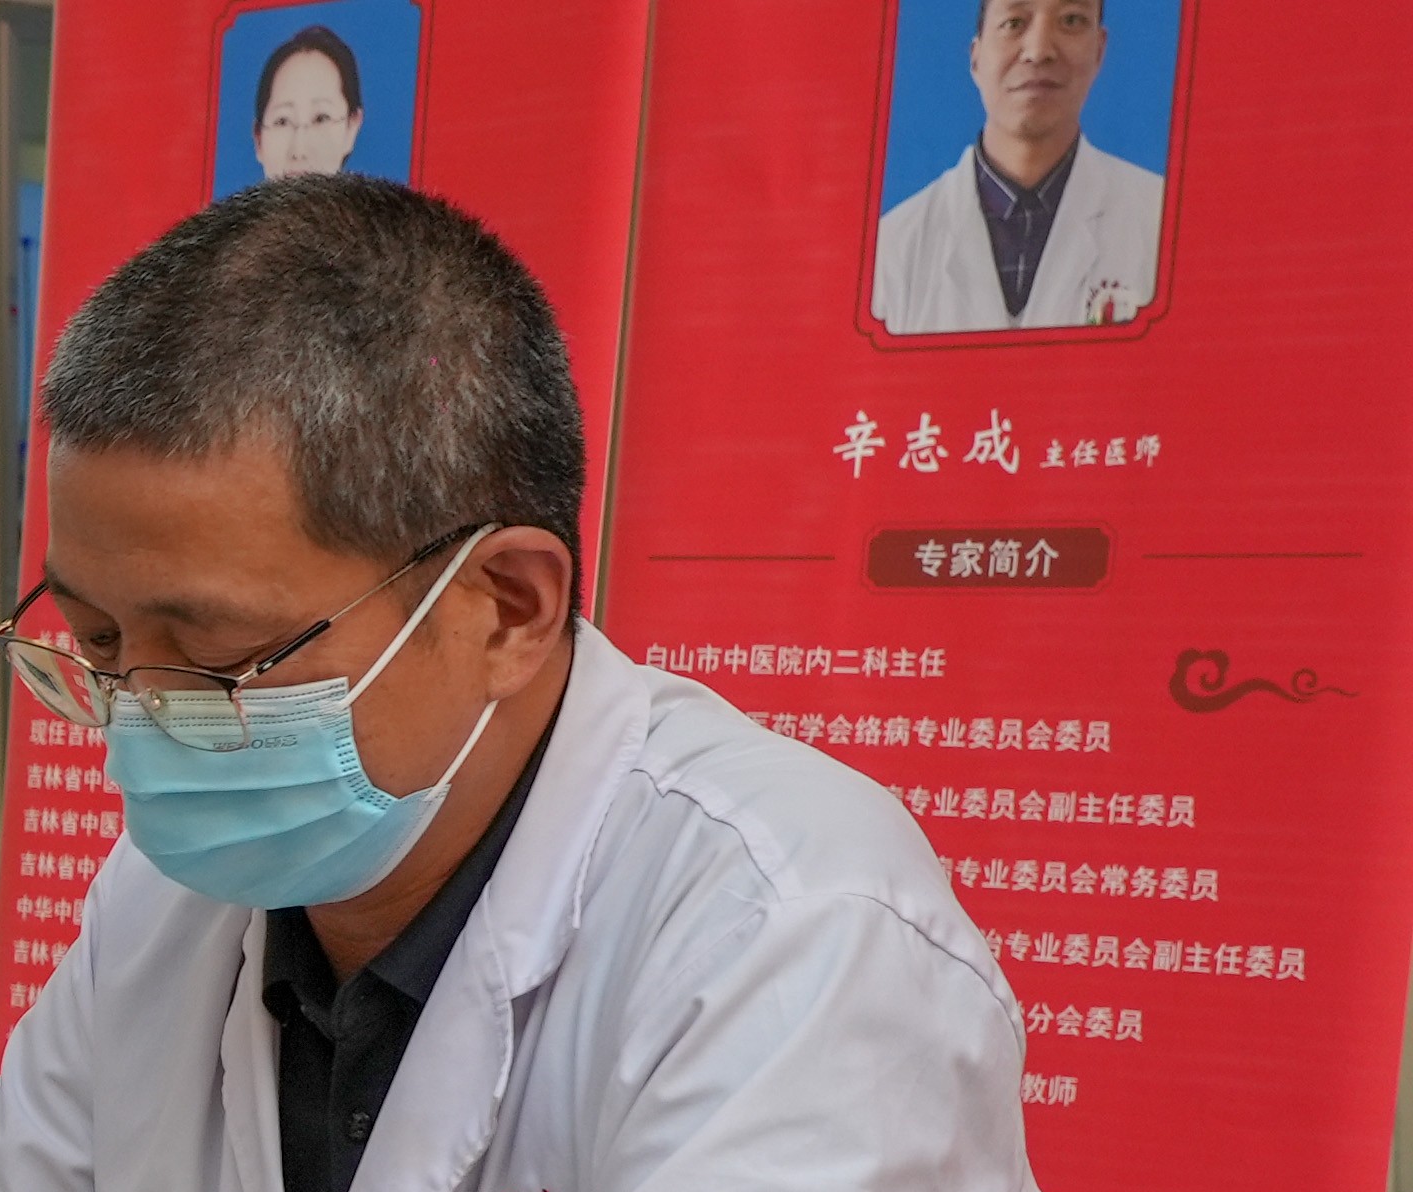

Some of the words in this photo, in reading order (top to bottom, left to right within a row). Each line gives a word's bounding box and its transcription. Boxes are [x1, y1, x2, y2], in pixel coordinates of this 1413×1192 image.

[833, 408, 1020, 479] 辛志成
[1040, 433, 1161, 468] 主任医师
[913, 537, 1060, 579] 专家简介
[646, 642, 947, 679] 白山市中医院内二科主任
[1016, 1000, 1143, 1043] 分会委员
